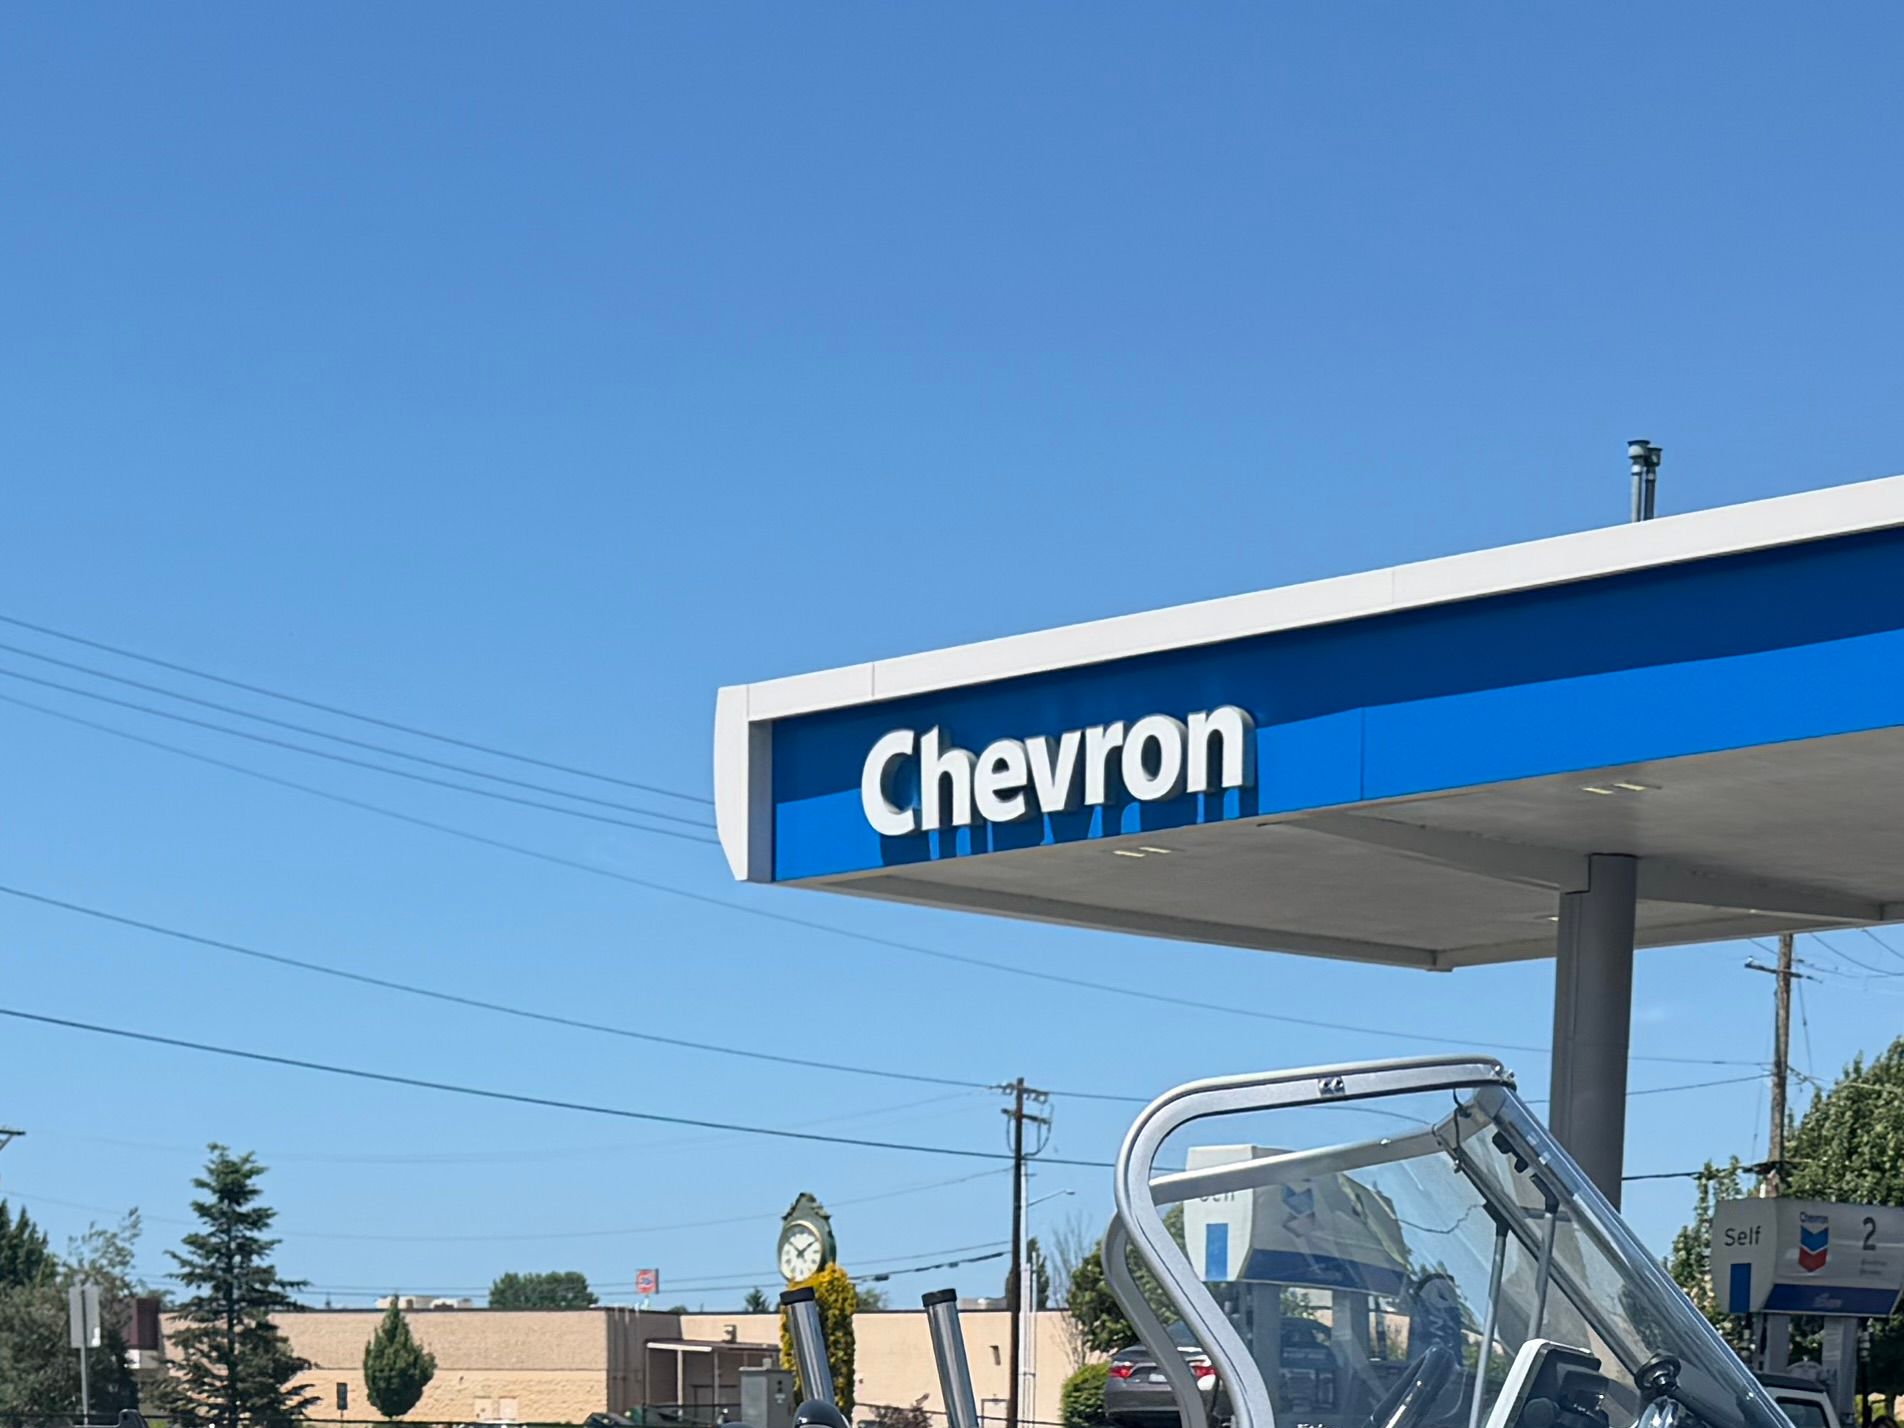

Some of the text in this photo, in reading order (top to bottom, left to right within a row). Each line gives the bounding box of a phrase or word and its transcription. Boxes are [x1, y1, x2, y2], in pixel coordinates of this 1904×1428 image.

[861, 704, 1251, 837] Chevron
[1724, 1225, 1762, 1247] Self
[1862, 1216, 1877, 1251] 2
